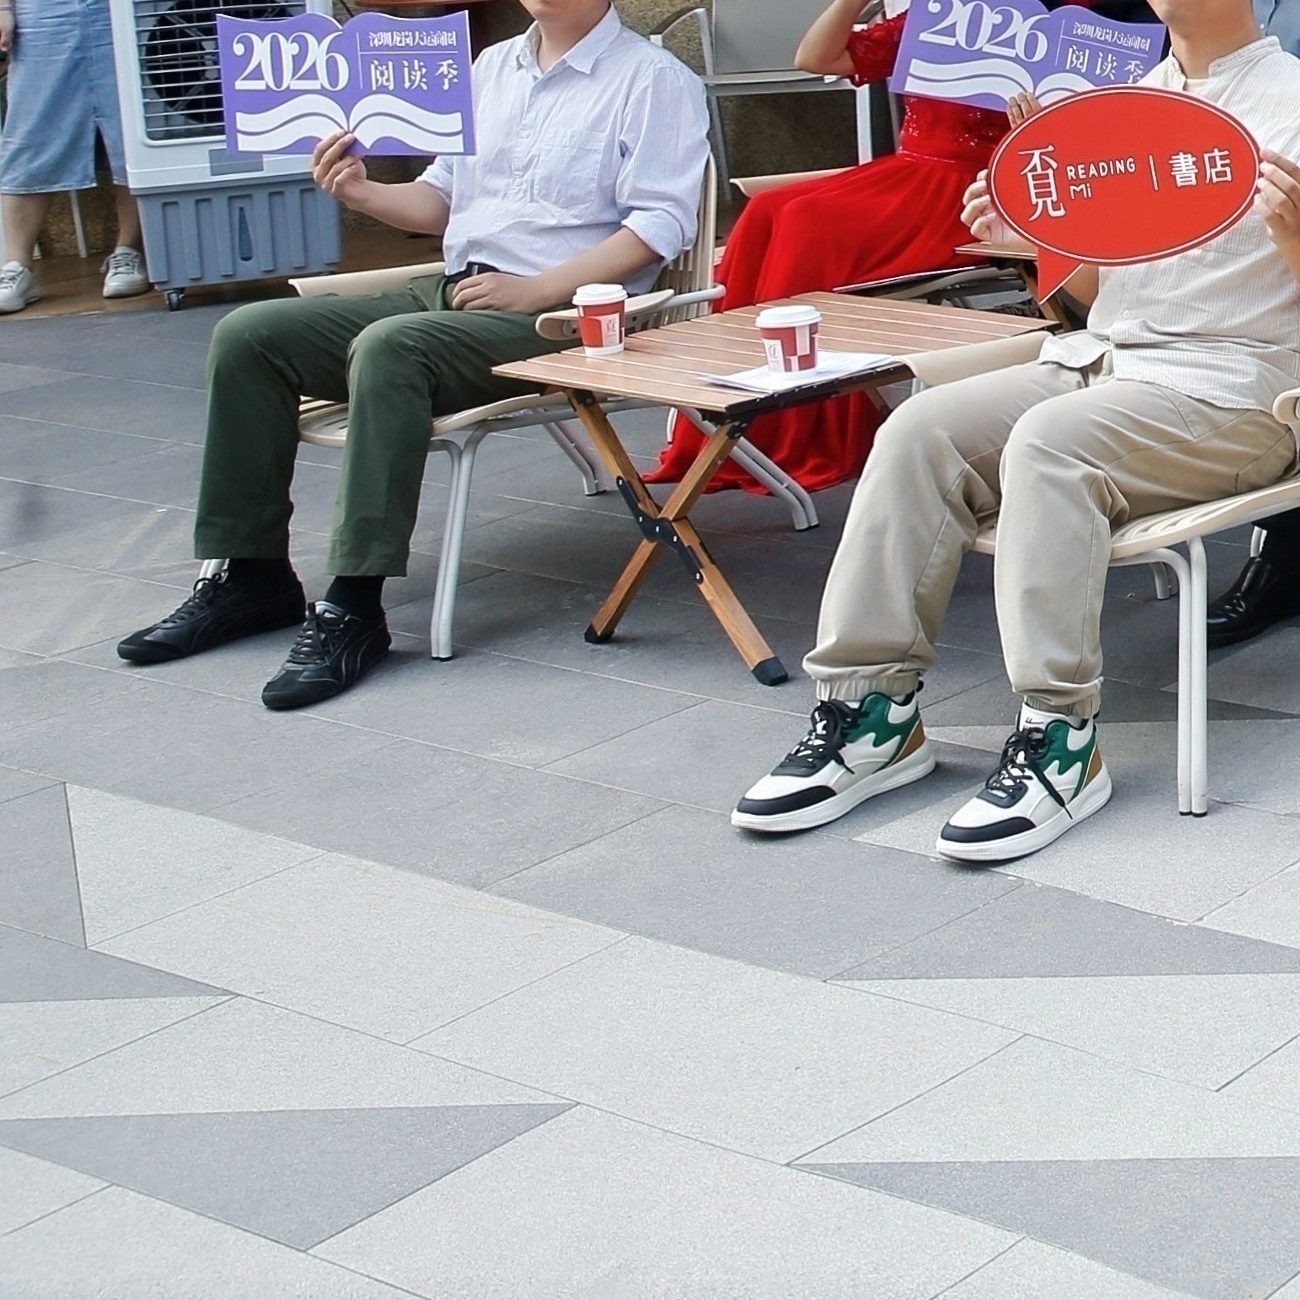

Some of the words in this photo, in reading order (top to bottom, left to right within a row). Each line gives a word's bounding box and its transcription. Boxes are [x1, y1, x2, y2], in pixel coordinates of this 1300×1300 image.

[232, 31, 349, 92] 2026
[369, 58, 459, 91] 阅读季
[1065, 44, 1145, 85] 阅读季
[1066, 157, 1137, 181] READING
[1168, 147, 1233, 188] 書店
[1069, 183, 1092, 200] Mi
